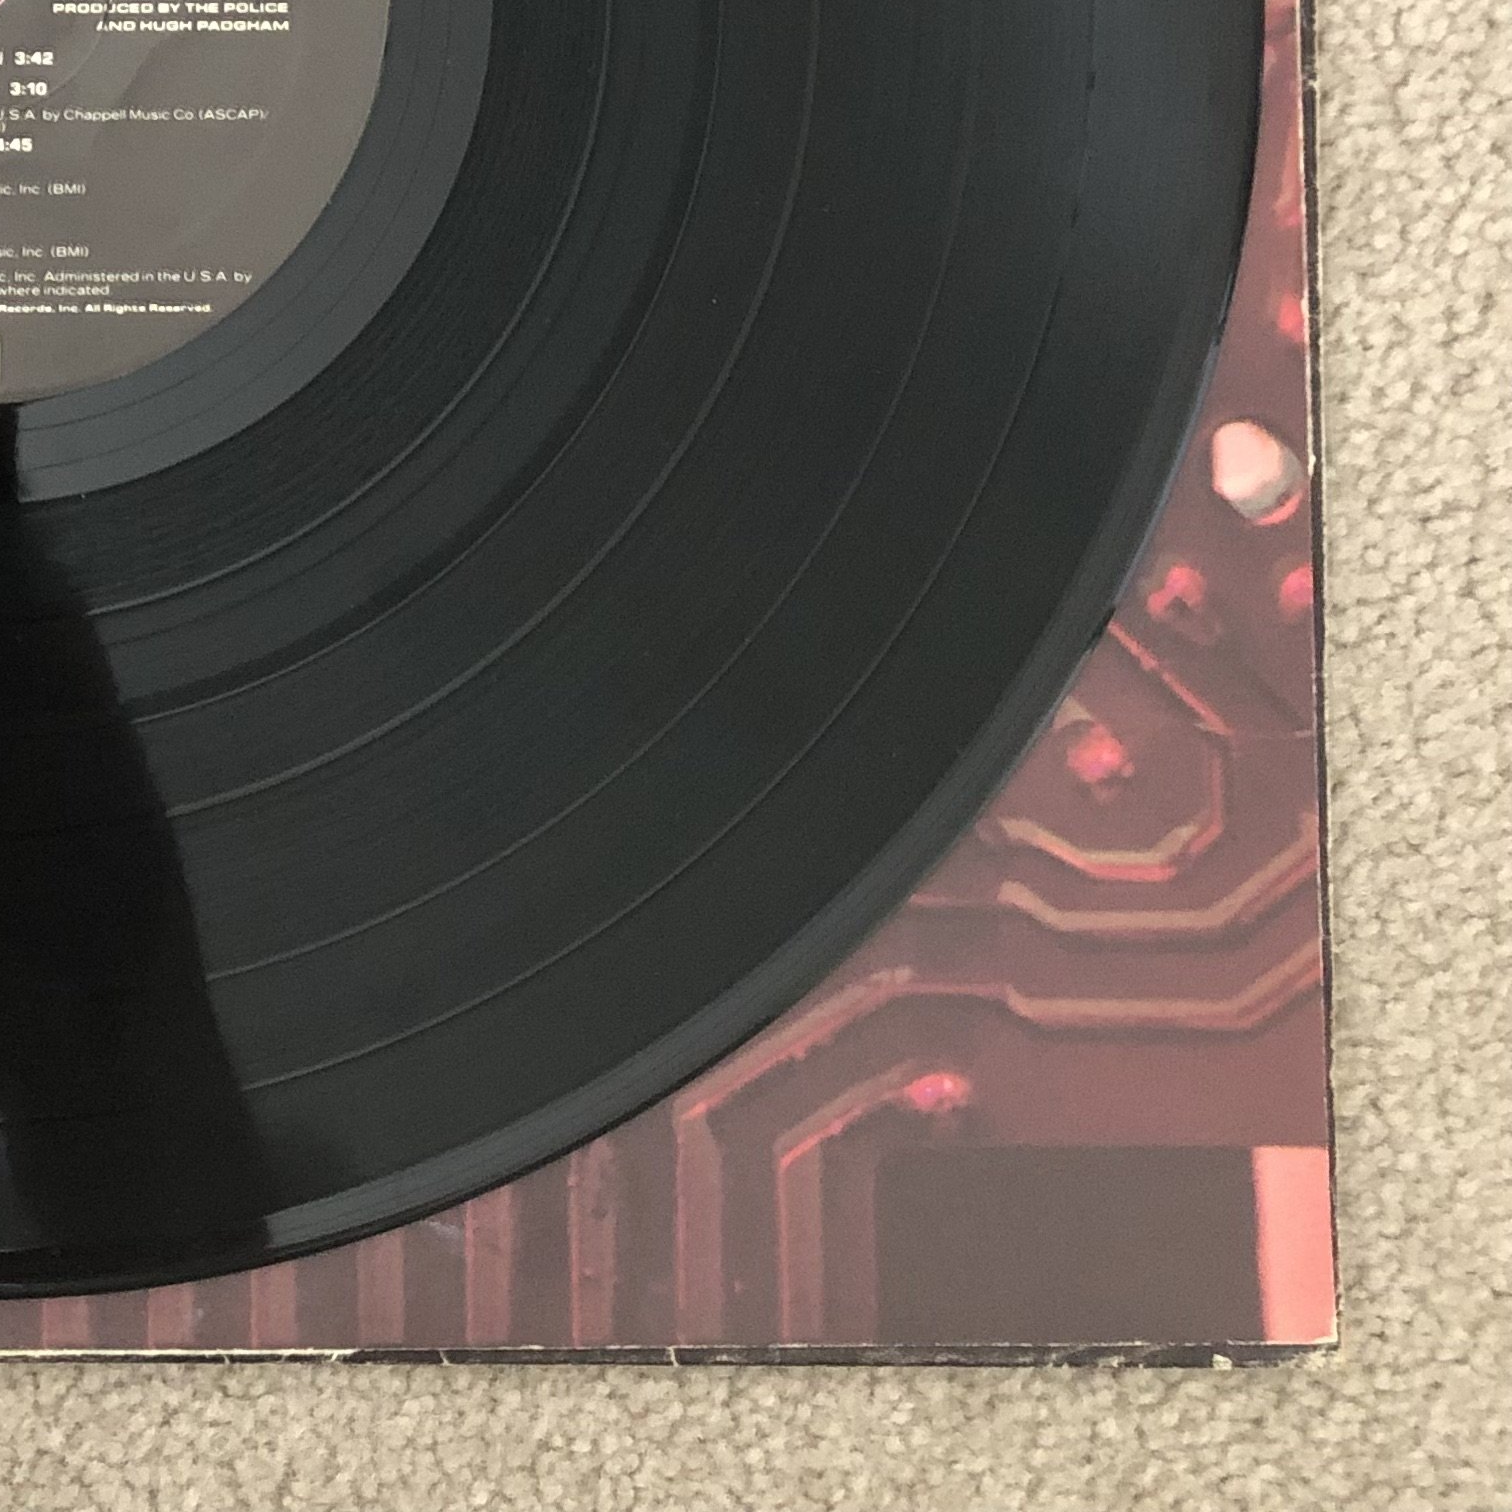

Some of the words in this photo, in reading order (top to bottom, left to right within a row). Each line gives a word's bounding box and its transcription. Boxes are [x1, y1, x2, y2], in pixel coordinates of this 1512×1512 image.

[53, 2, 153, 14] PRODUCED
[158, 2, 180, 14] BY
[185, 2, 219, 14] THE
[223, 2, 288, 14] POLICE
[140, 20, 193, 32] HUGH
[197, 20, 290, 32] PADGHAM
[14, 51, 54, 65] 3:42
[9, 82, 48, 96] 3:10
[42, 109, 61, 123] by
[63, 109, 126, 123] Chappell
[129, 109, 171, 121] Music
[44, 271, 139, 283] Administered
[157, 271, 180, 283] the
[233, 271, 252, 285] by
